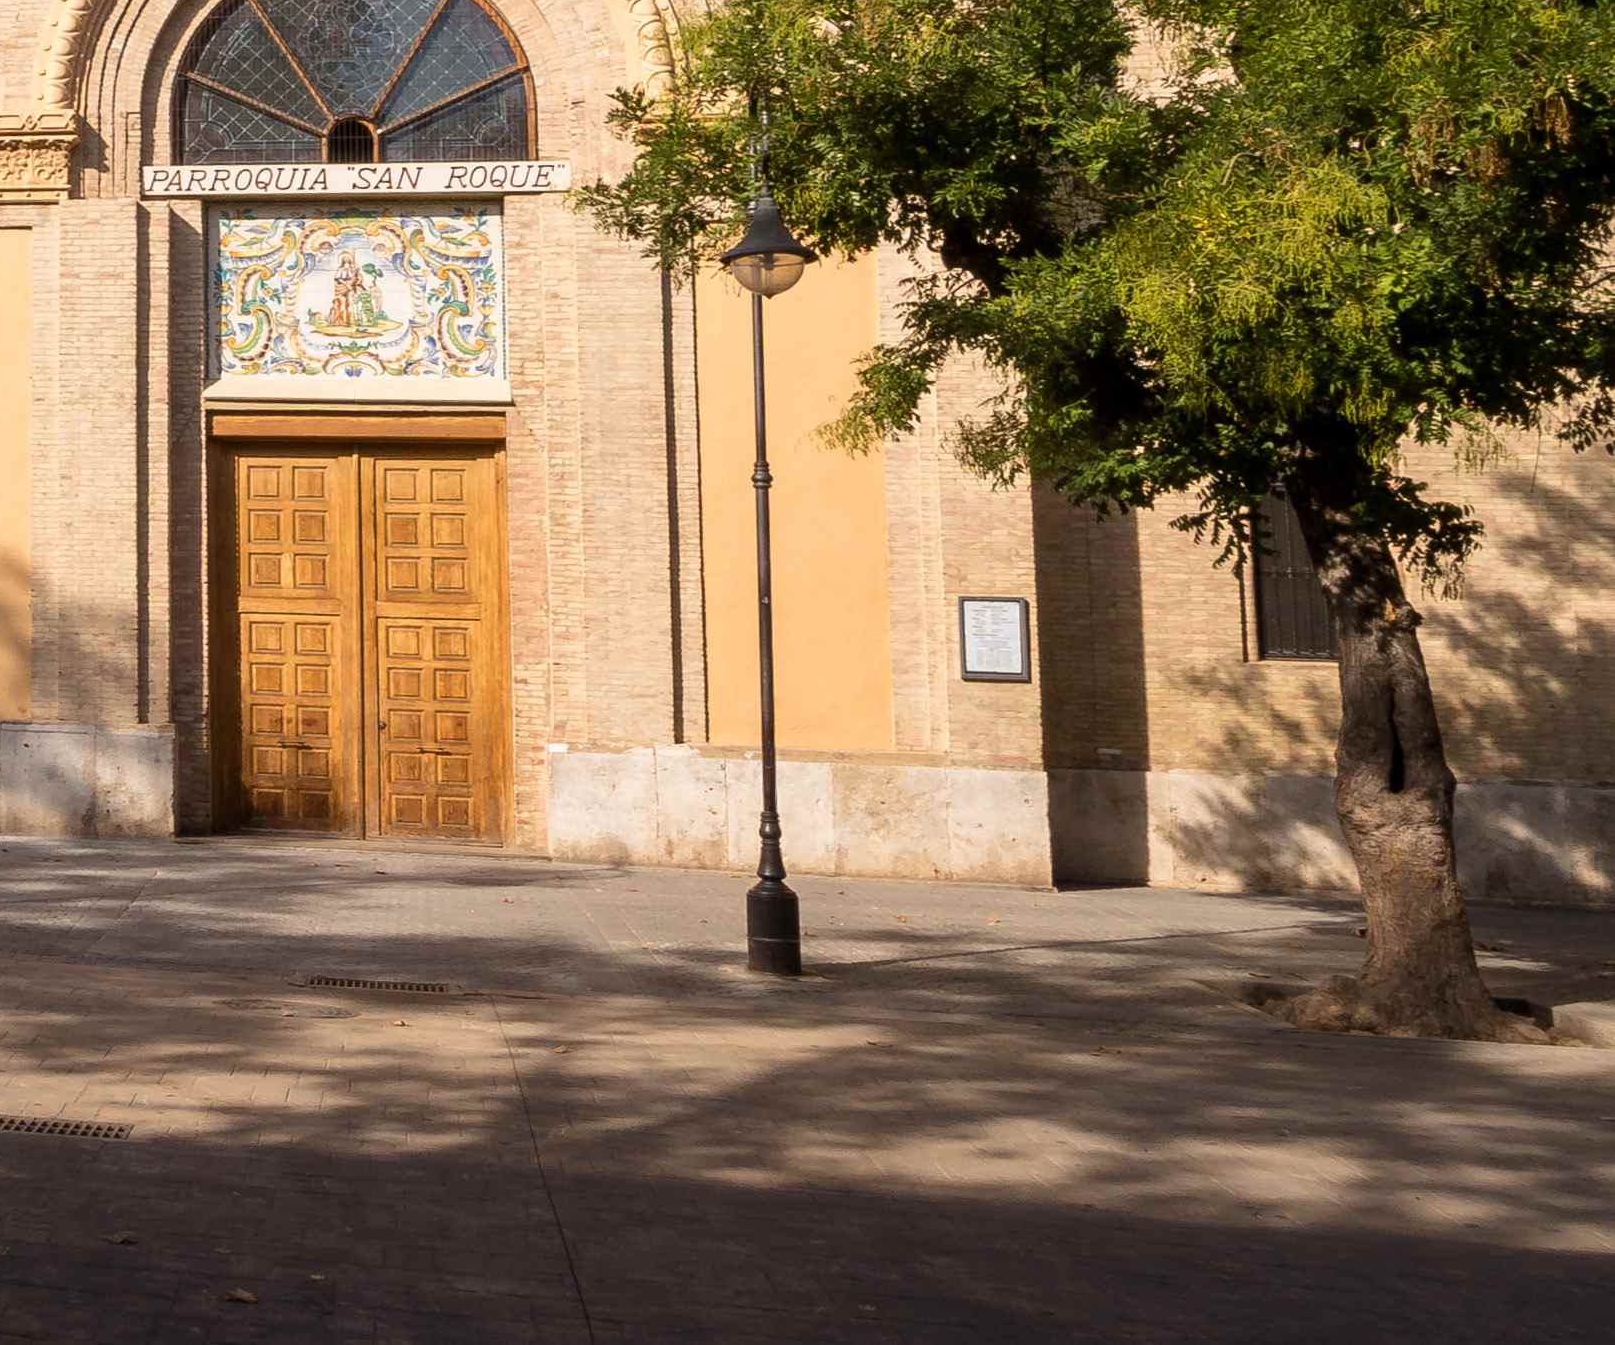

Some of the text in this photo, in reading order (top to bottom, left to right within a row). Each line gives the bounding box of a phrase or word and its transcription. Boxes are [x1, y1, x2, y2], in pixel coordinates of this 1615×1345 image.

[145, 163, 566, 192] PARROQUIA "SAN ROQUE"
